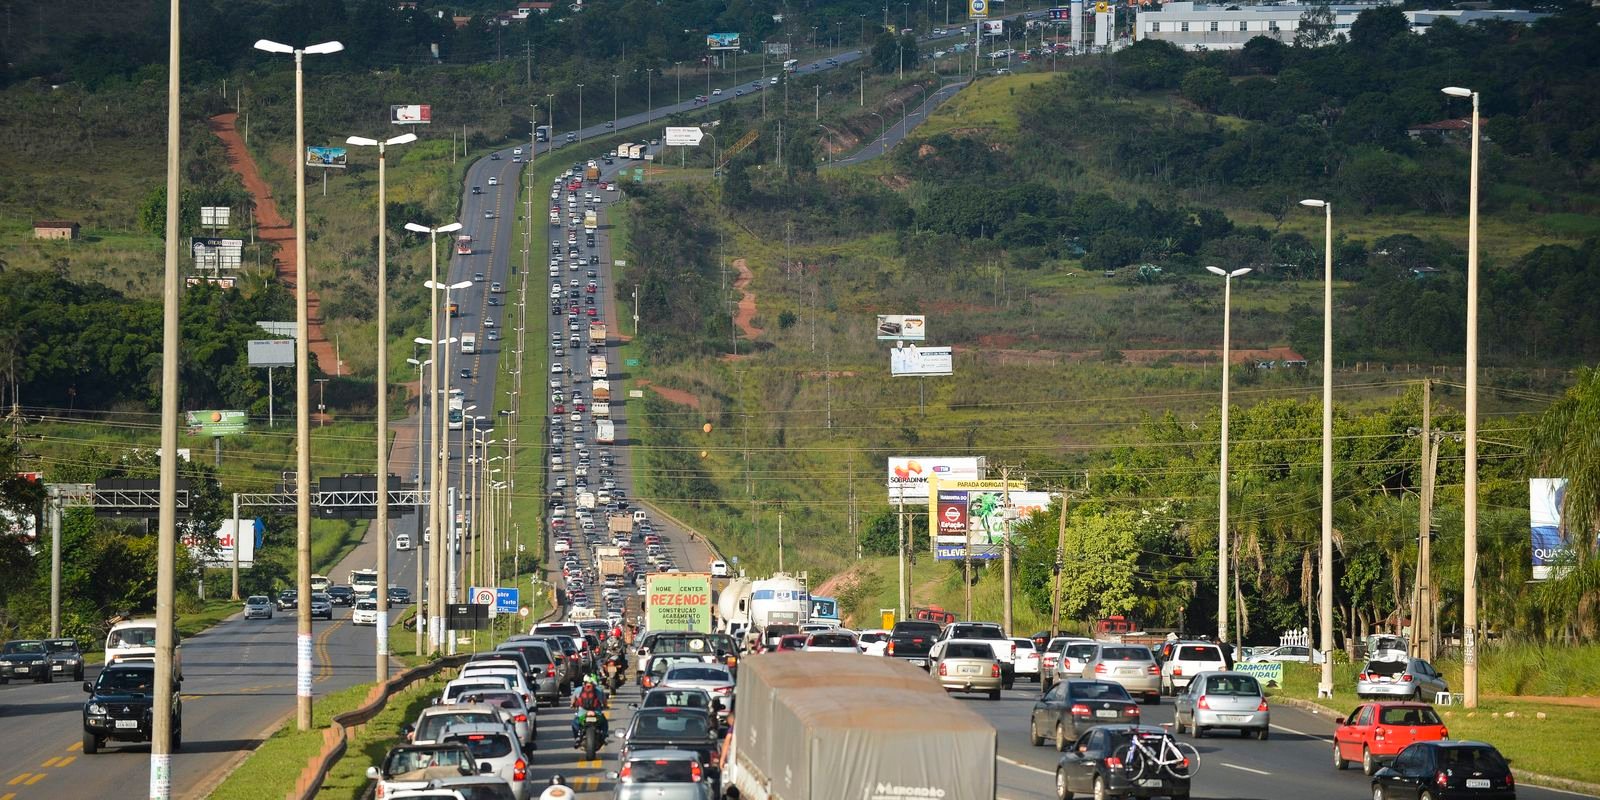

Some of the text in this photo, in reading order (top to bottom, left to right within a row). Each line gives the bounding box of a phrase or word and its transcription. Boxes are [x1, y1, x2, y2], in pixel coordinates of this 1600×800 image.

[480, 593, 490, 601] 80
[650, 594, 707, 605] REZENDE
[1235, 663, 1282, 671] PAMONHA
